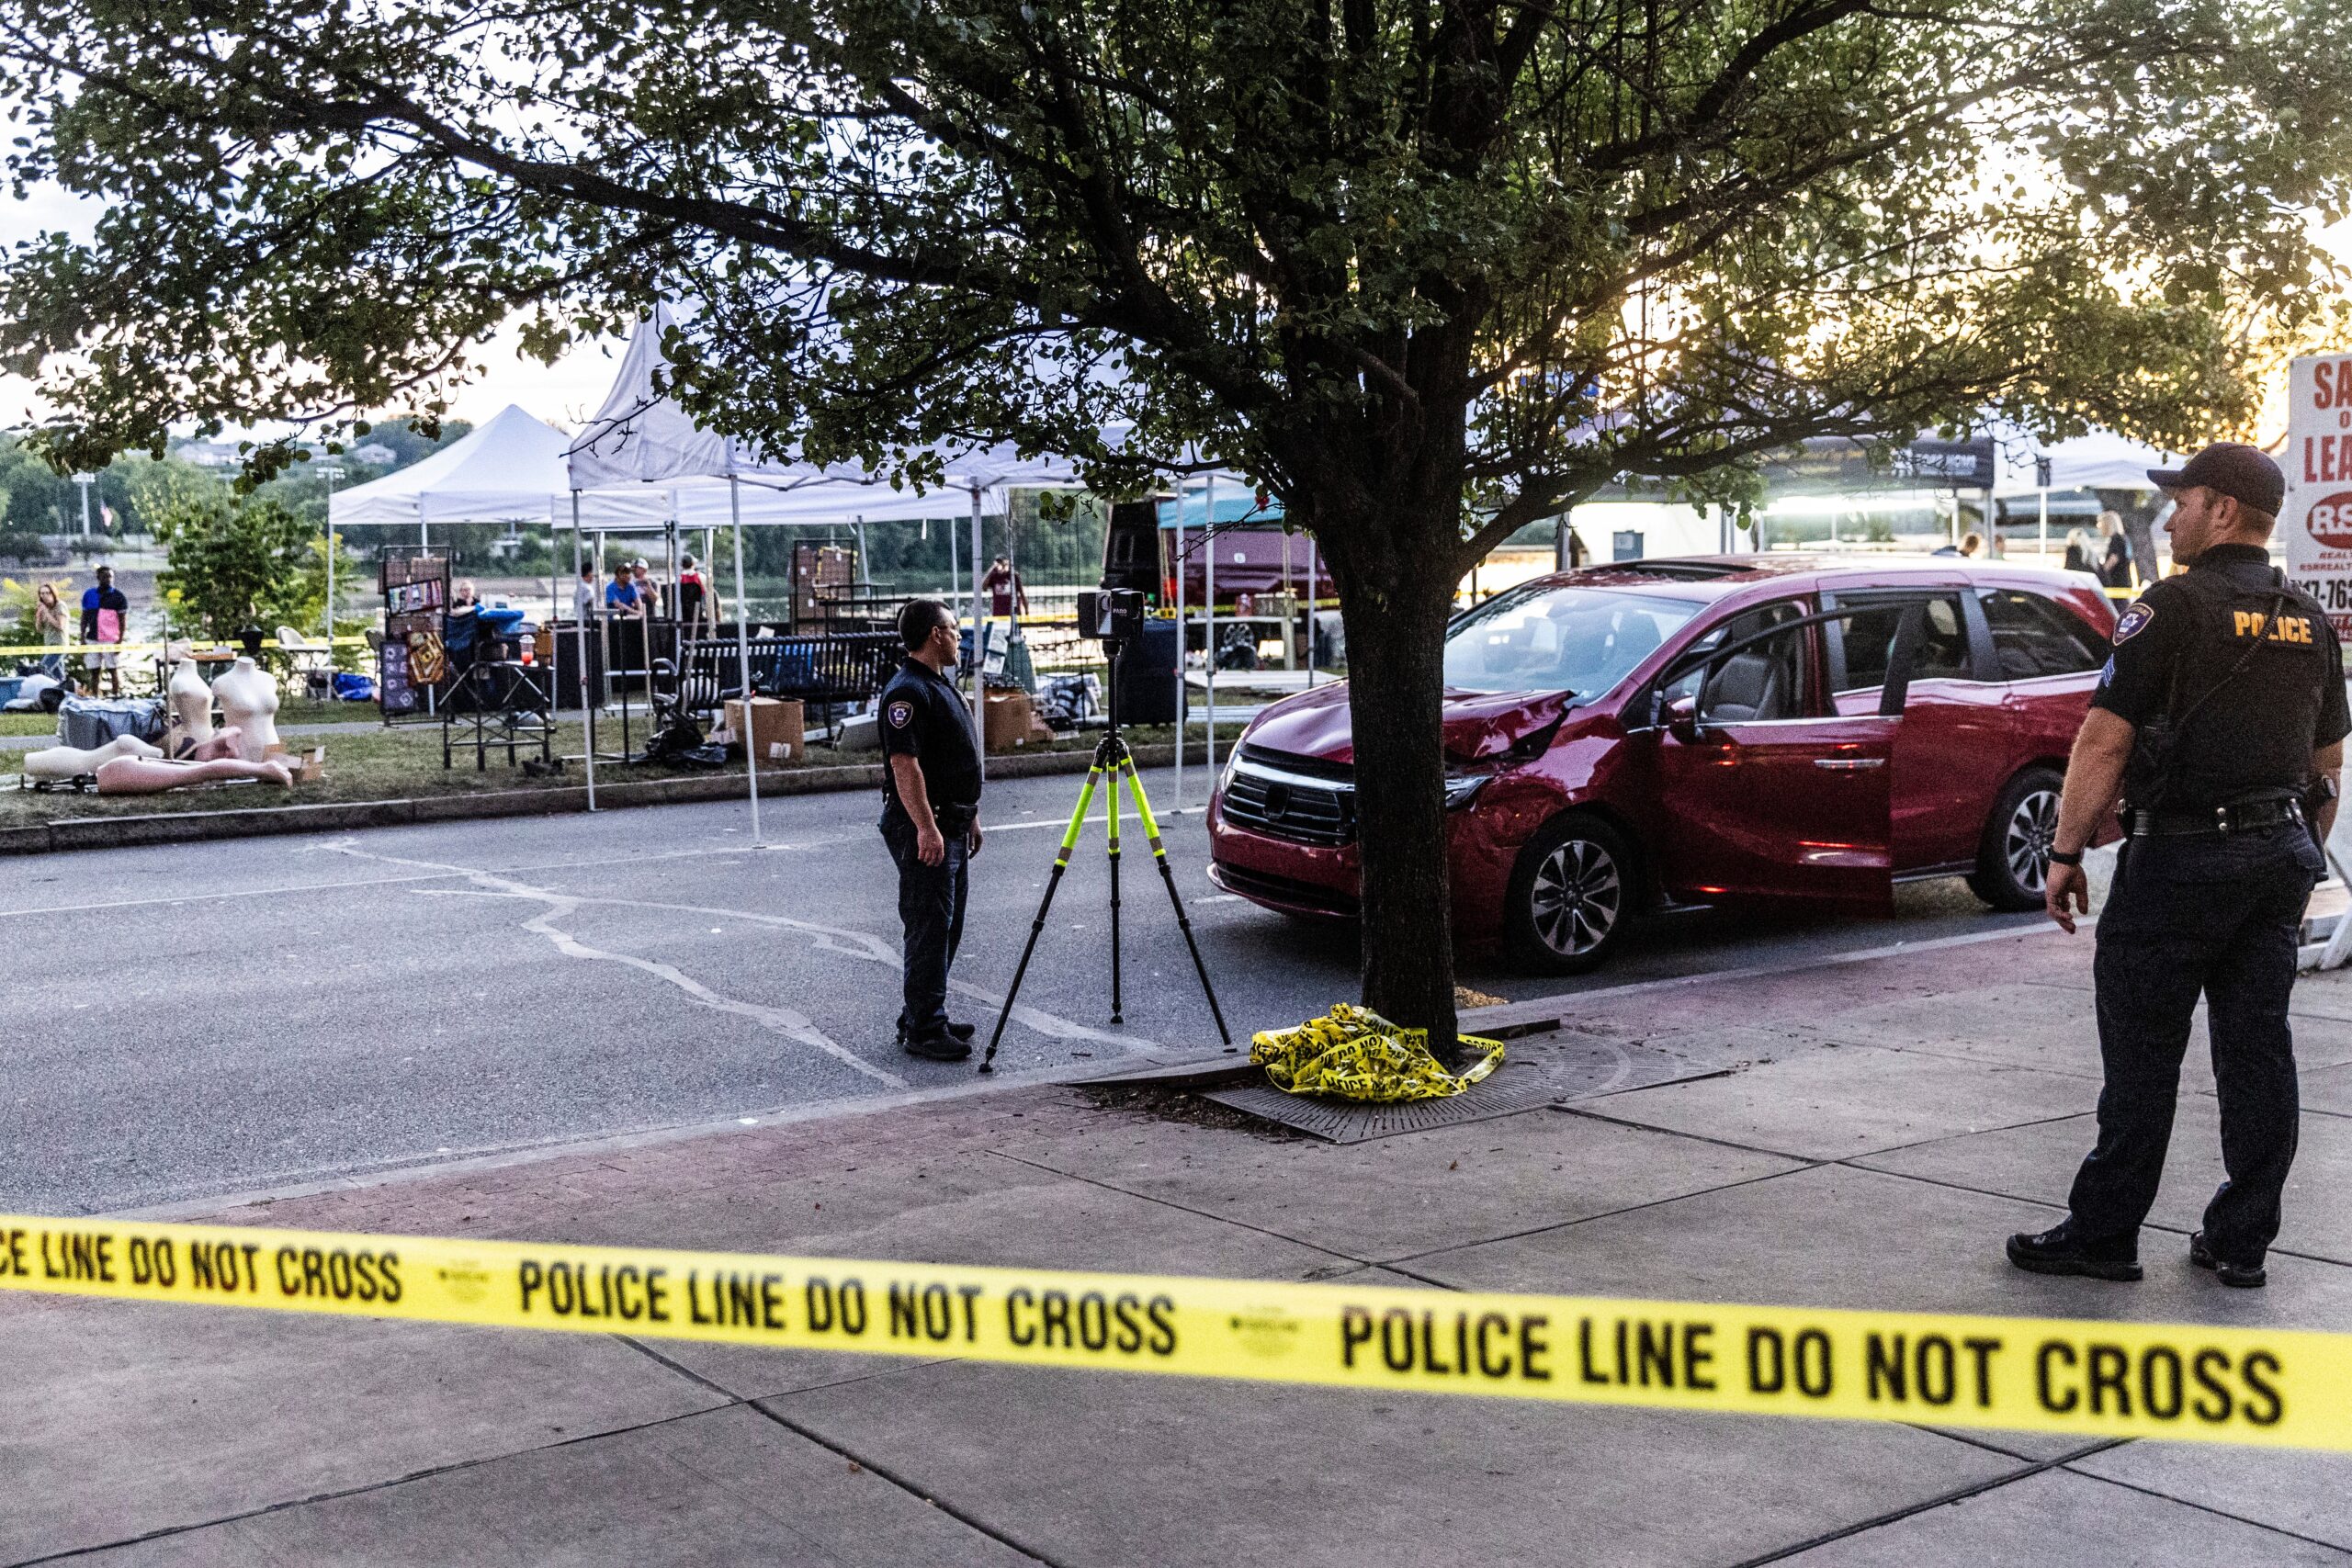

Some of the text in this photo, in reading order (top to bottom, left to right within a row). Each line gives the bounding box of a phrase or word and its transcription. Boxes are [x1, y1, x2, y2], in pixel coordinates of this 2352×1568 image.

[41, 1231, 116, 1283] LINE
[130, 1235, 176, 1288] DO
[189, 1241, 259, 1292] NOT
[276, 1247, 402, 1304] CROSS
[518, 1259, 670, 1323] POLICE
[687, 1270, 786, 1331] LINE
[805, 1277, 868, 1337] DO
[887, 1282, 985, 1344] NOT
[1005, 1287, 1178, 1358] CROSS
[1340, 1305, 1553, 1382] POLICE
[1577, 1316, 1718, 1393] LINE
[1746, 1325, 1835, 1400] DO
[1864, 1332, 2004, 1409] NOT
[2034, 1338, 2284, 1427] CROSS
